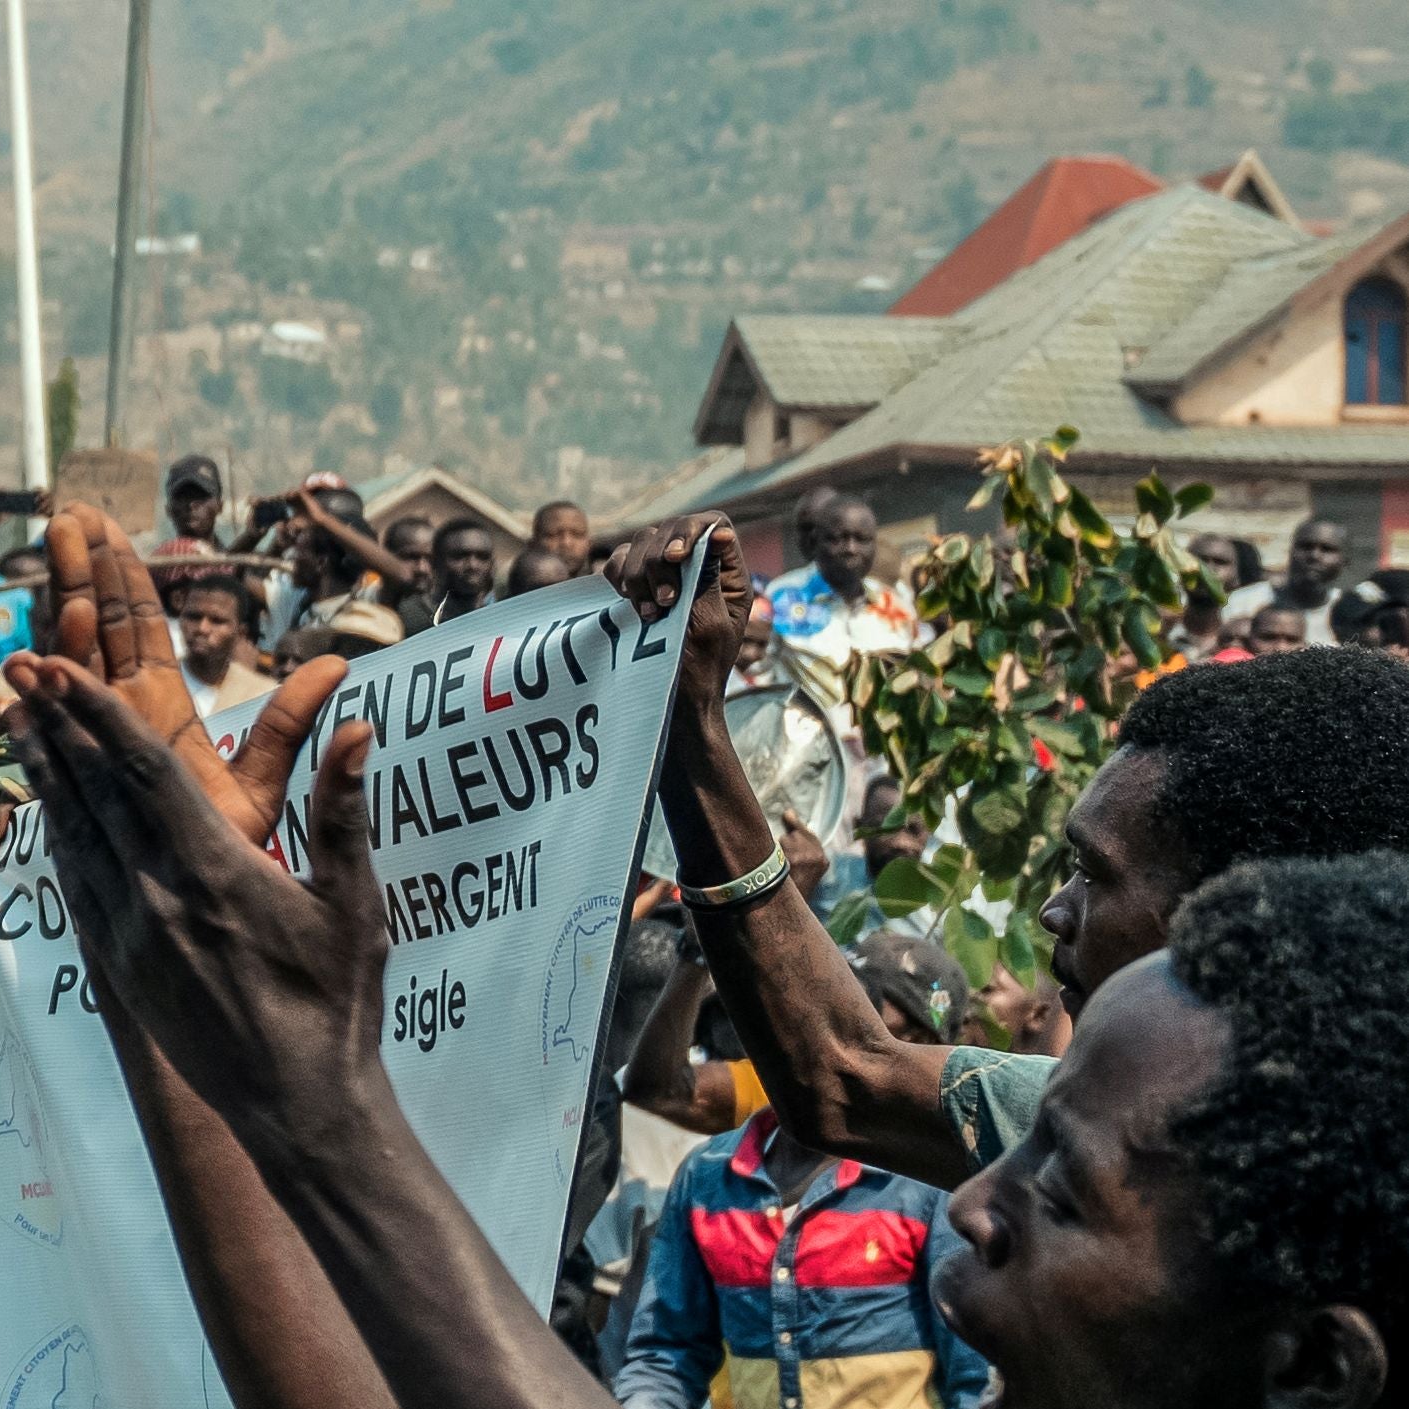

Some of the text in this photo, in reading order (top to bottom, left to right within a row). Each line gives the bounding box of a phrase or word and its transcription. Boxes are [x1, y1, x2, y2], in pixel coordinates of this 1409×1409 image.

[405, 645, 474, 740] DE
[393, 968, 467, 1053] sigle
[24, 1335, 63, 1374] CITOYEN
